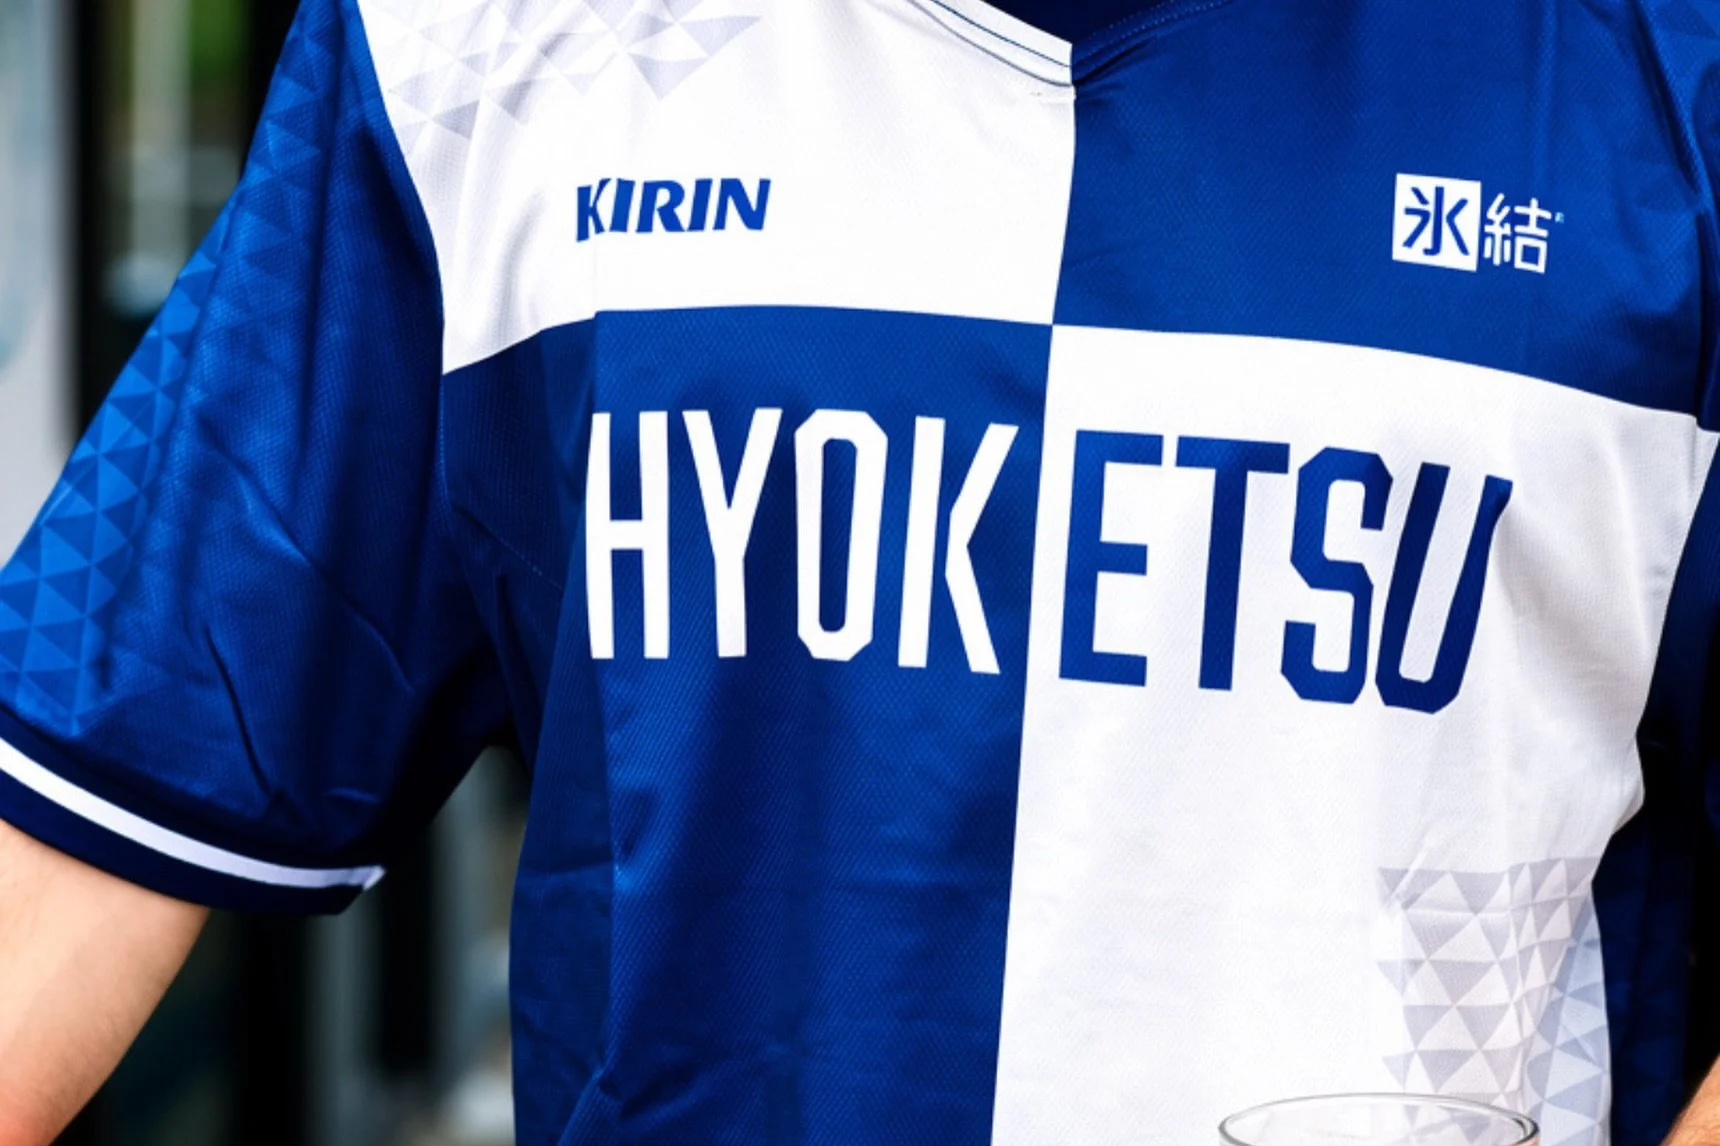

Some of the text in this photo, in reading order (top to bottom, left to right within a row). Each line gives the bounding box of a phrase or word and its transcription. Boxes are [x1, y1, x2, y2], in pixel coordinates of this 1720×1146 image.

[576, 177, 771, 243] KIRIN
[1392, 172, 1552, 274] 氷結
[585, 407, 1513, 714] HYOKETSU
